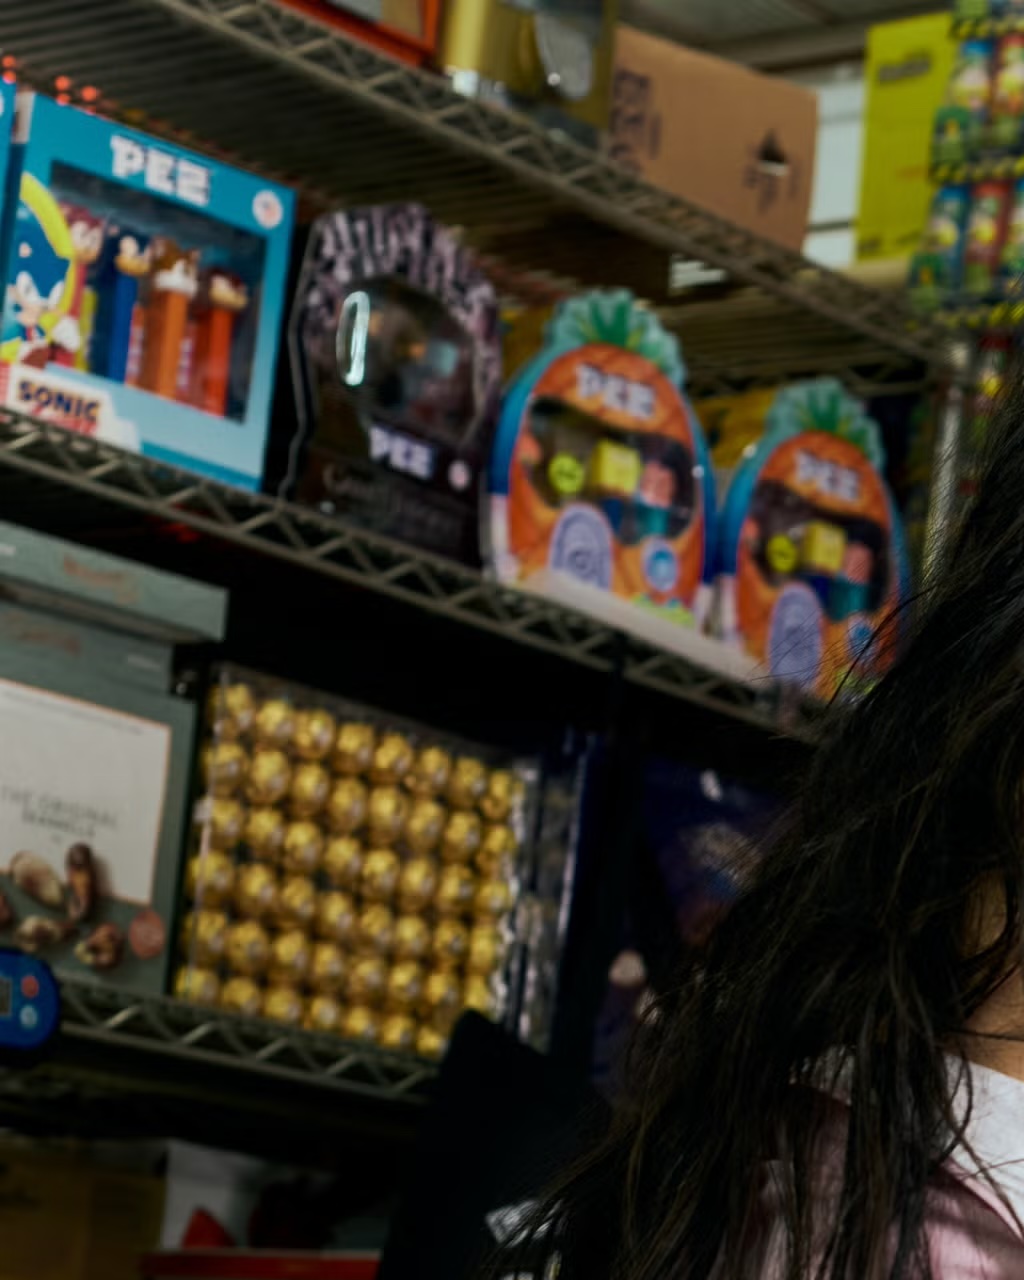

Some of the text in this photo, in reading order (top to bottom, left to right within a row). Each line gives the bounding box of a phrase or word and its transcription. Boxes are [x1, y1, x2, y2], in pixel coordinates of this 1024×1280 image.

[109, 134, 210, 207] PEZ
[19, 380, 99, 423] SONIC
[576, 363, 654, 419] PEZ
[368, 422, 439, 481] PEZ
[795, 449, 859, 501] PEZ
